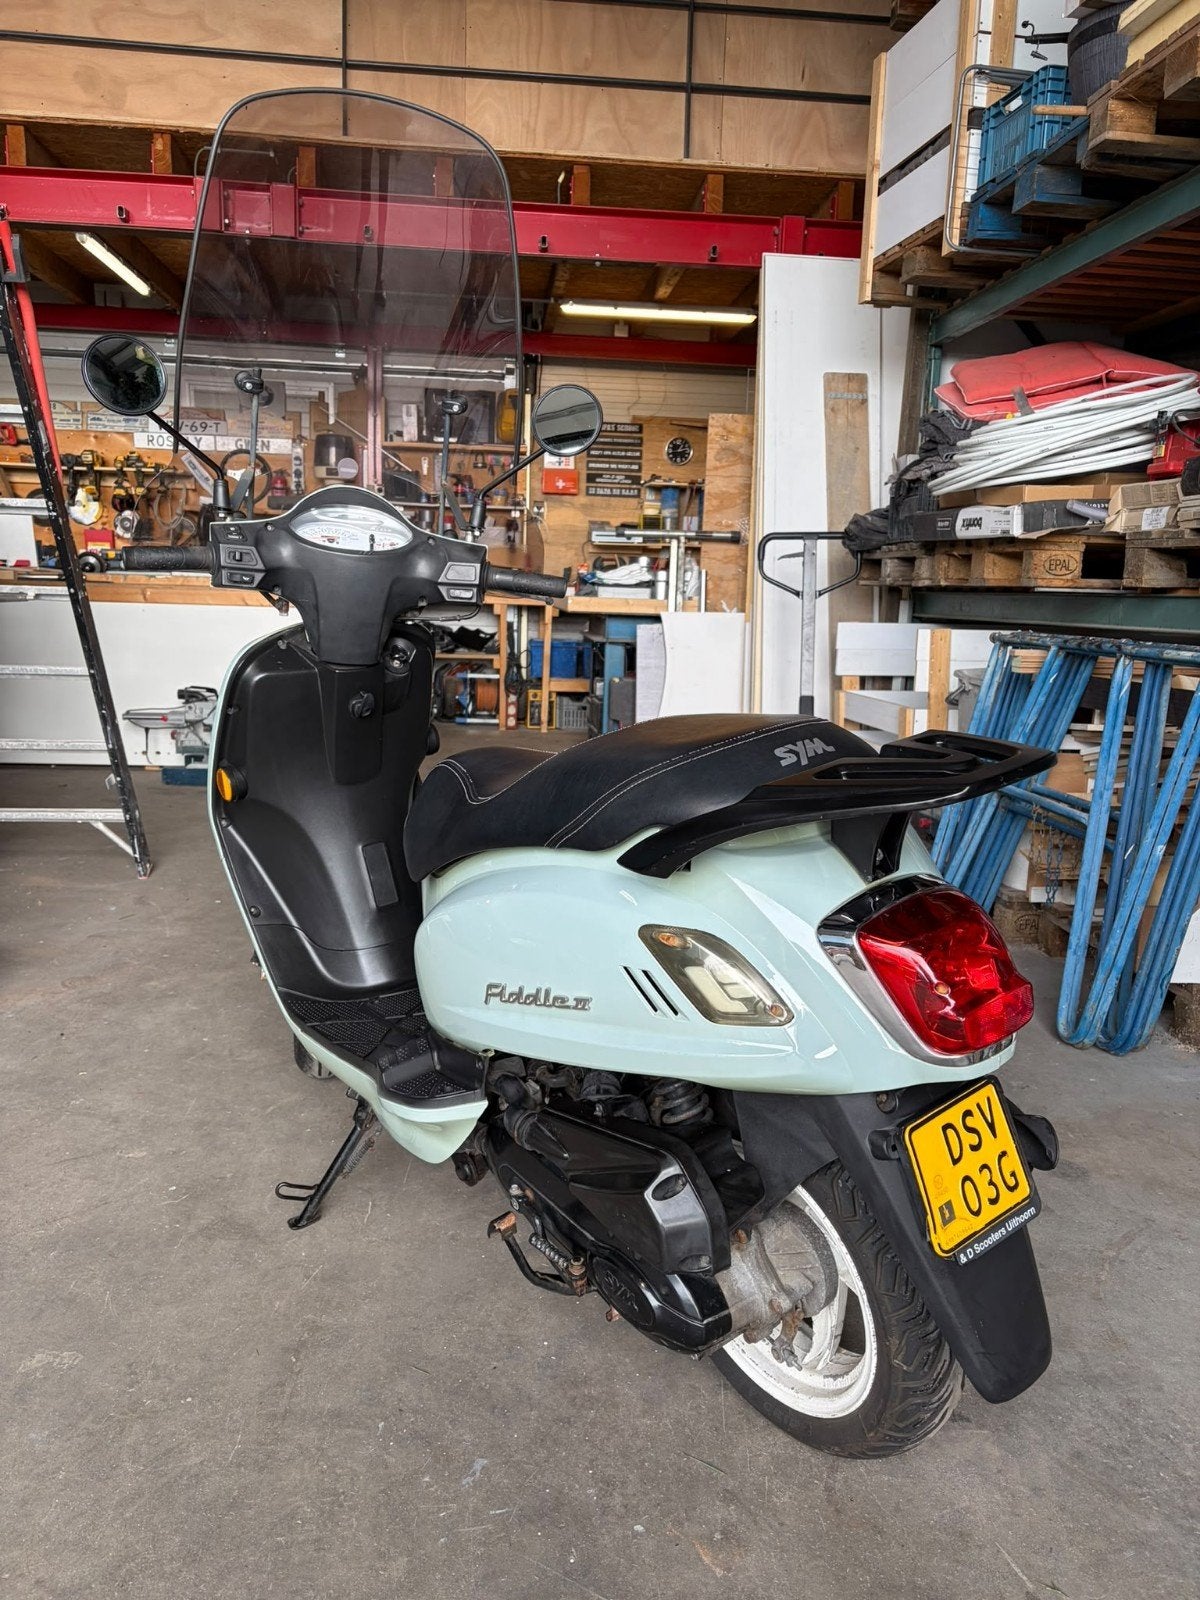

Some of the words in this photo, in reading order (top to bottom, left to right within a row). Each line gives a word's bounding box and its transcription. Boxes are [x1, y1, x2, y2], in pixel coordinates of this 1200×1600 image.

[1049, 558, 1073, 571] EPAL
[774, 737, 836, 767] SYM
[941, 1096, 998, 1167] DSV
[960, 1150, 1020, 1217] 03G
[967, 1247, 974, 1259] D
[974, 1227, 1007, 1254] Scooters
[1005, 1206, 1037, 1232] Uithoorn
